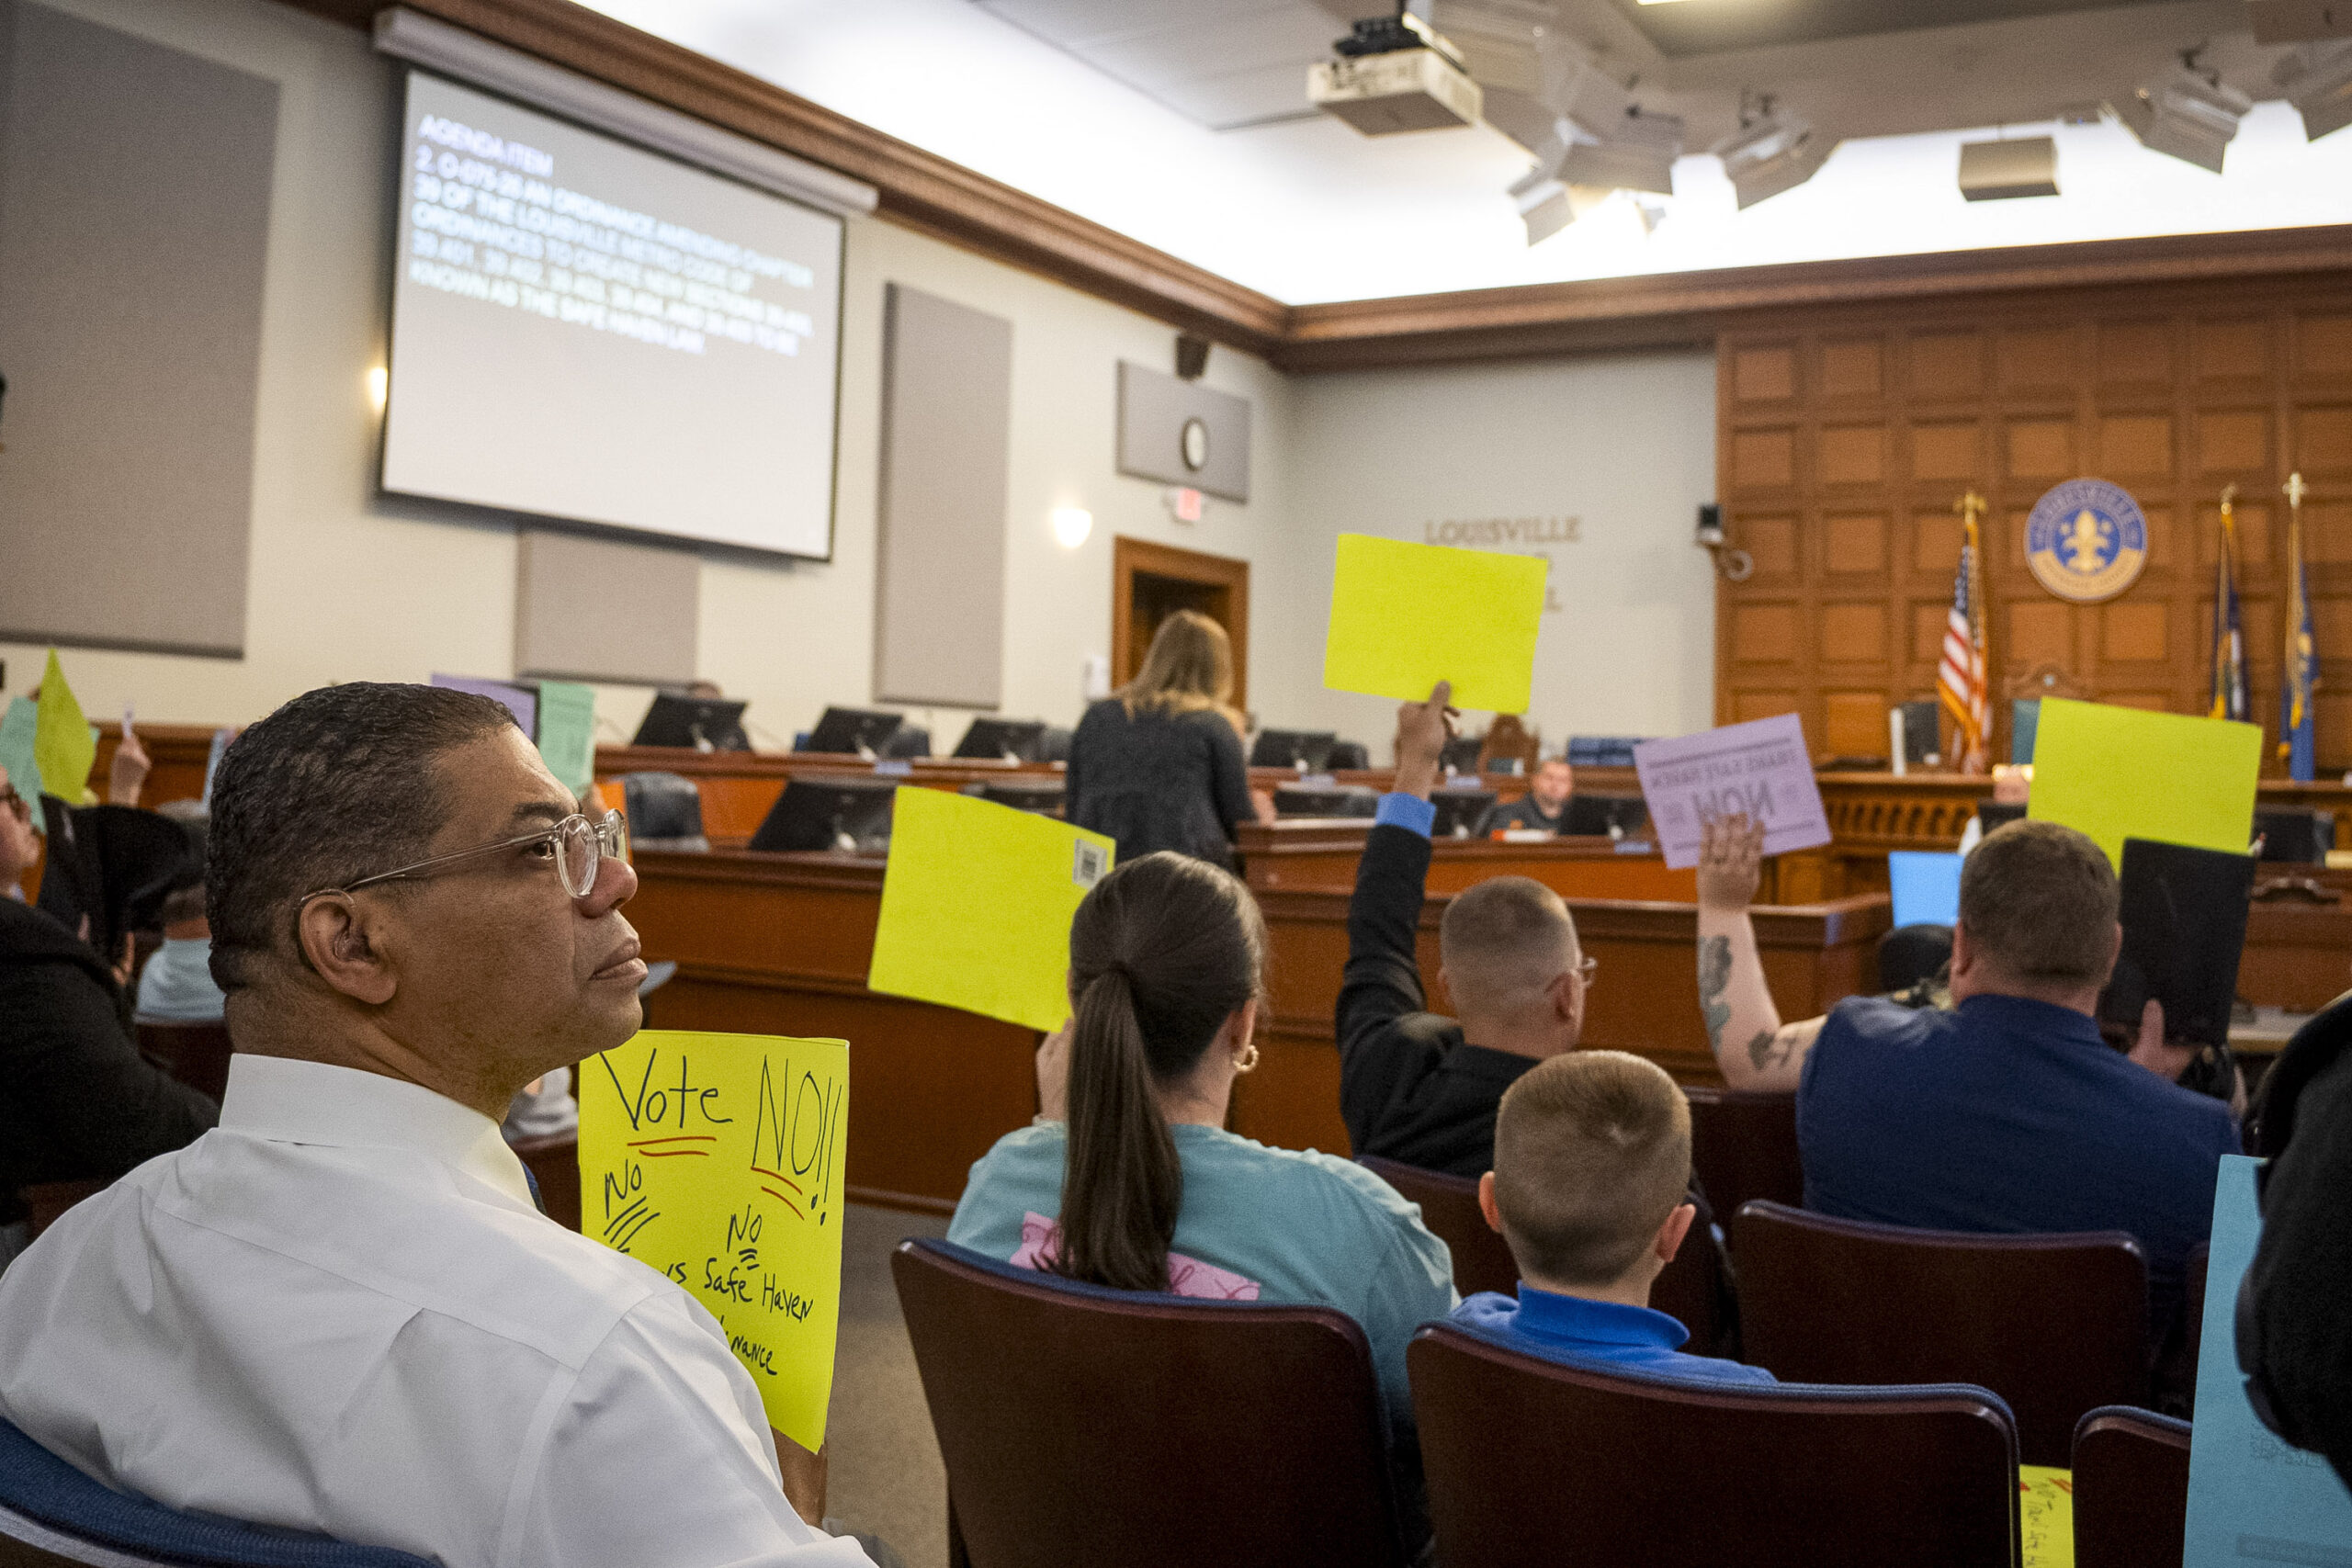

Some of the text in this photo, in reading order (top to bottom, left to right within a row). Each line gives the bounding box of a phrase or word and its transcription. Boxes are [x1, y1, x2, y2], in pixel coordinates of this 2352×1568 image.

[1424, 516, 1581, 546] LOUISVILLE
[599, 1047, 842, 1226] Vote NO!!
[704, 1258, 753, 1303] Safe
